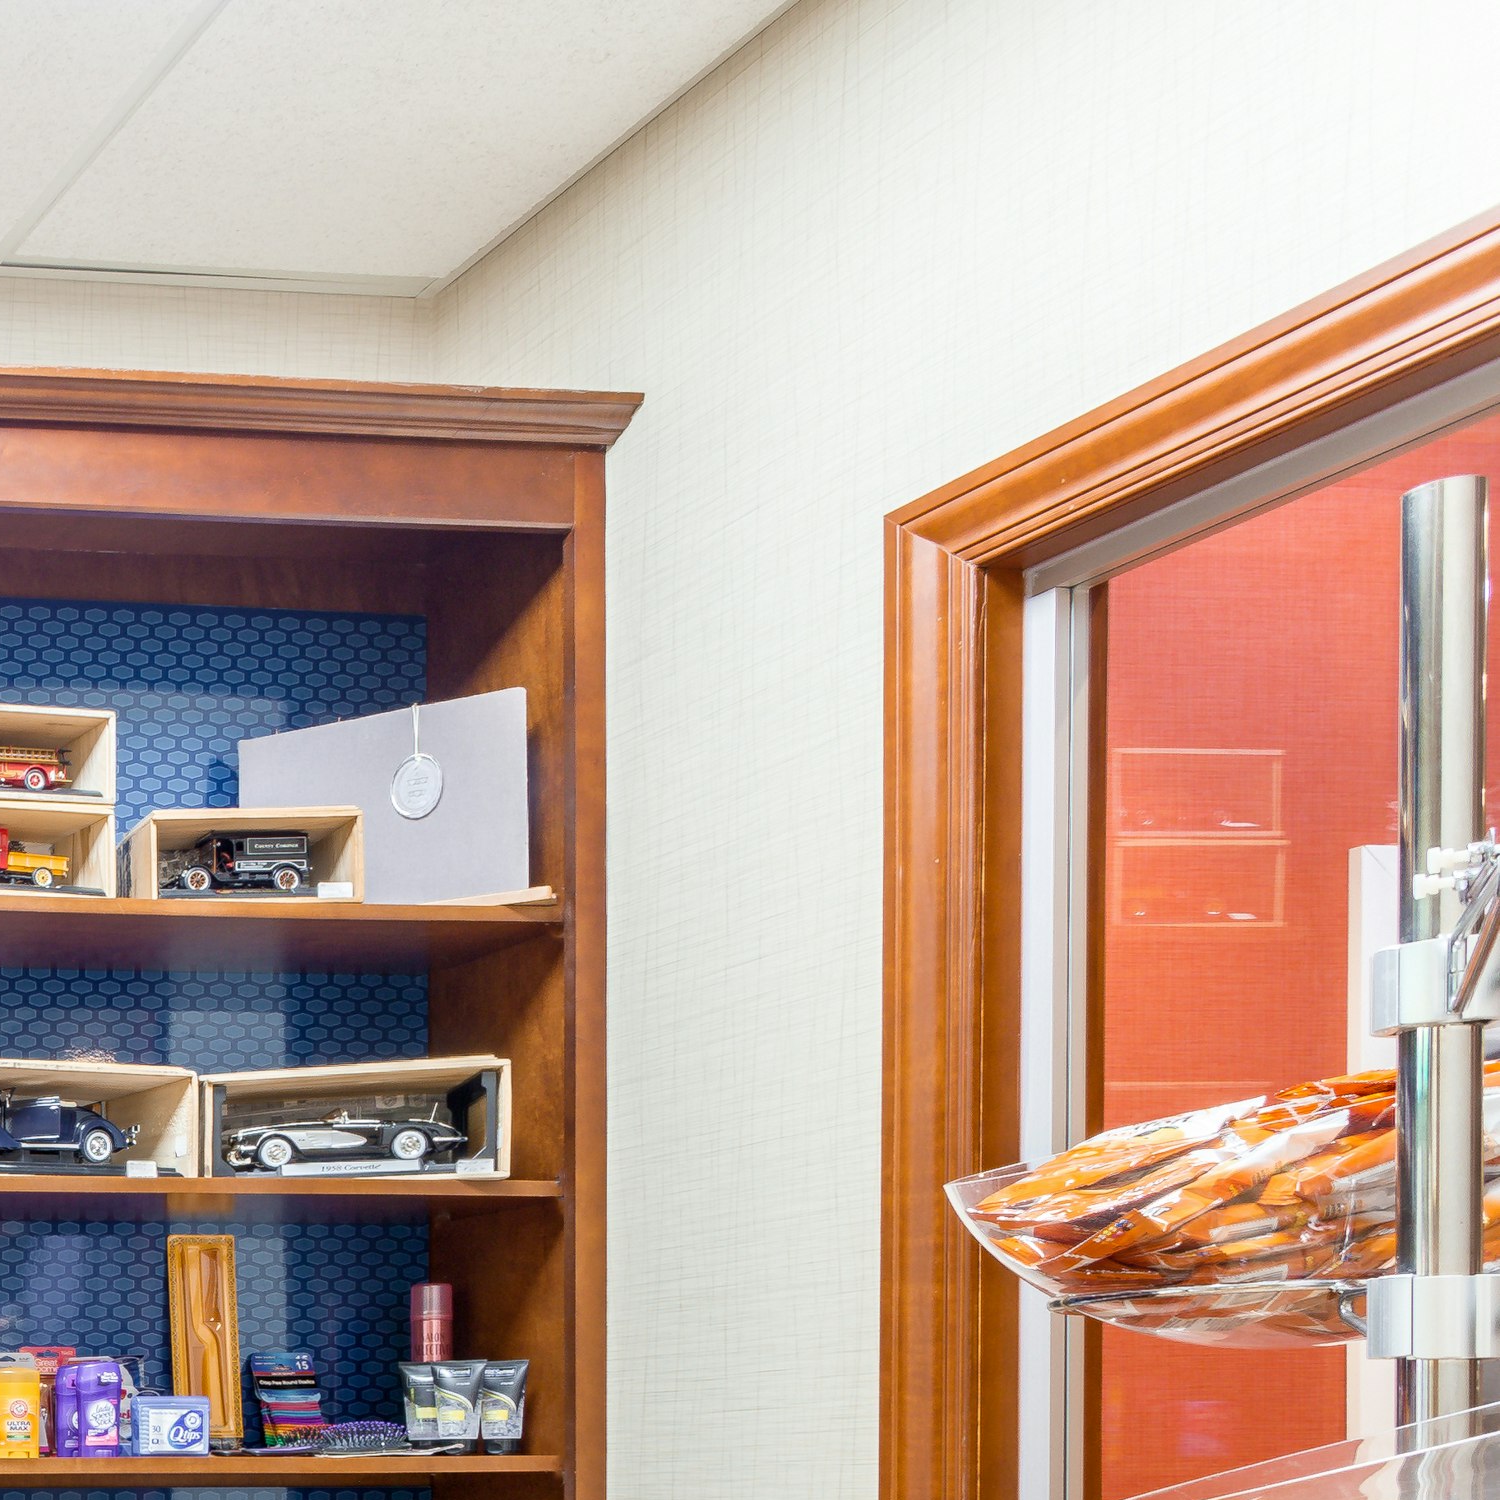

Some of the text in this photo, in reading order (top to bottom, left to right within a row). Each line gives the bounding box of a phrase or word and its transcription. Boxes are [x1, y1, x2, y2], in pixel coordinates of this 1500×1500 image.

[320, 1162, 382, 1172] 1958 Corvette
[34, 1357, 60, 1368] Great
[295, 1360, 310, 1371] 15
[151, 1425, 162, 1434] 30
